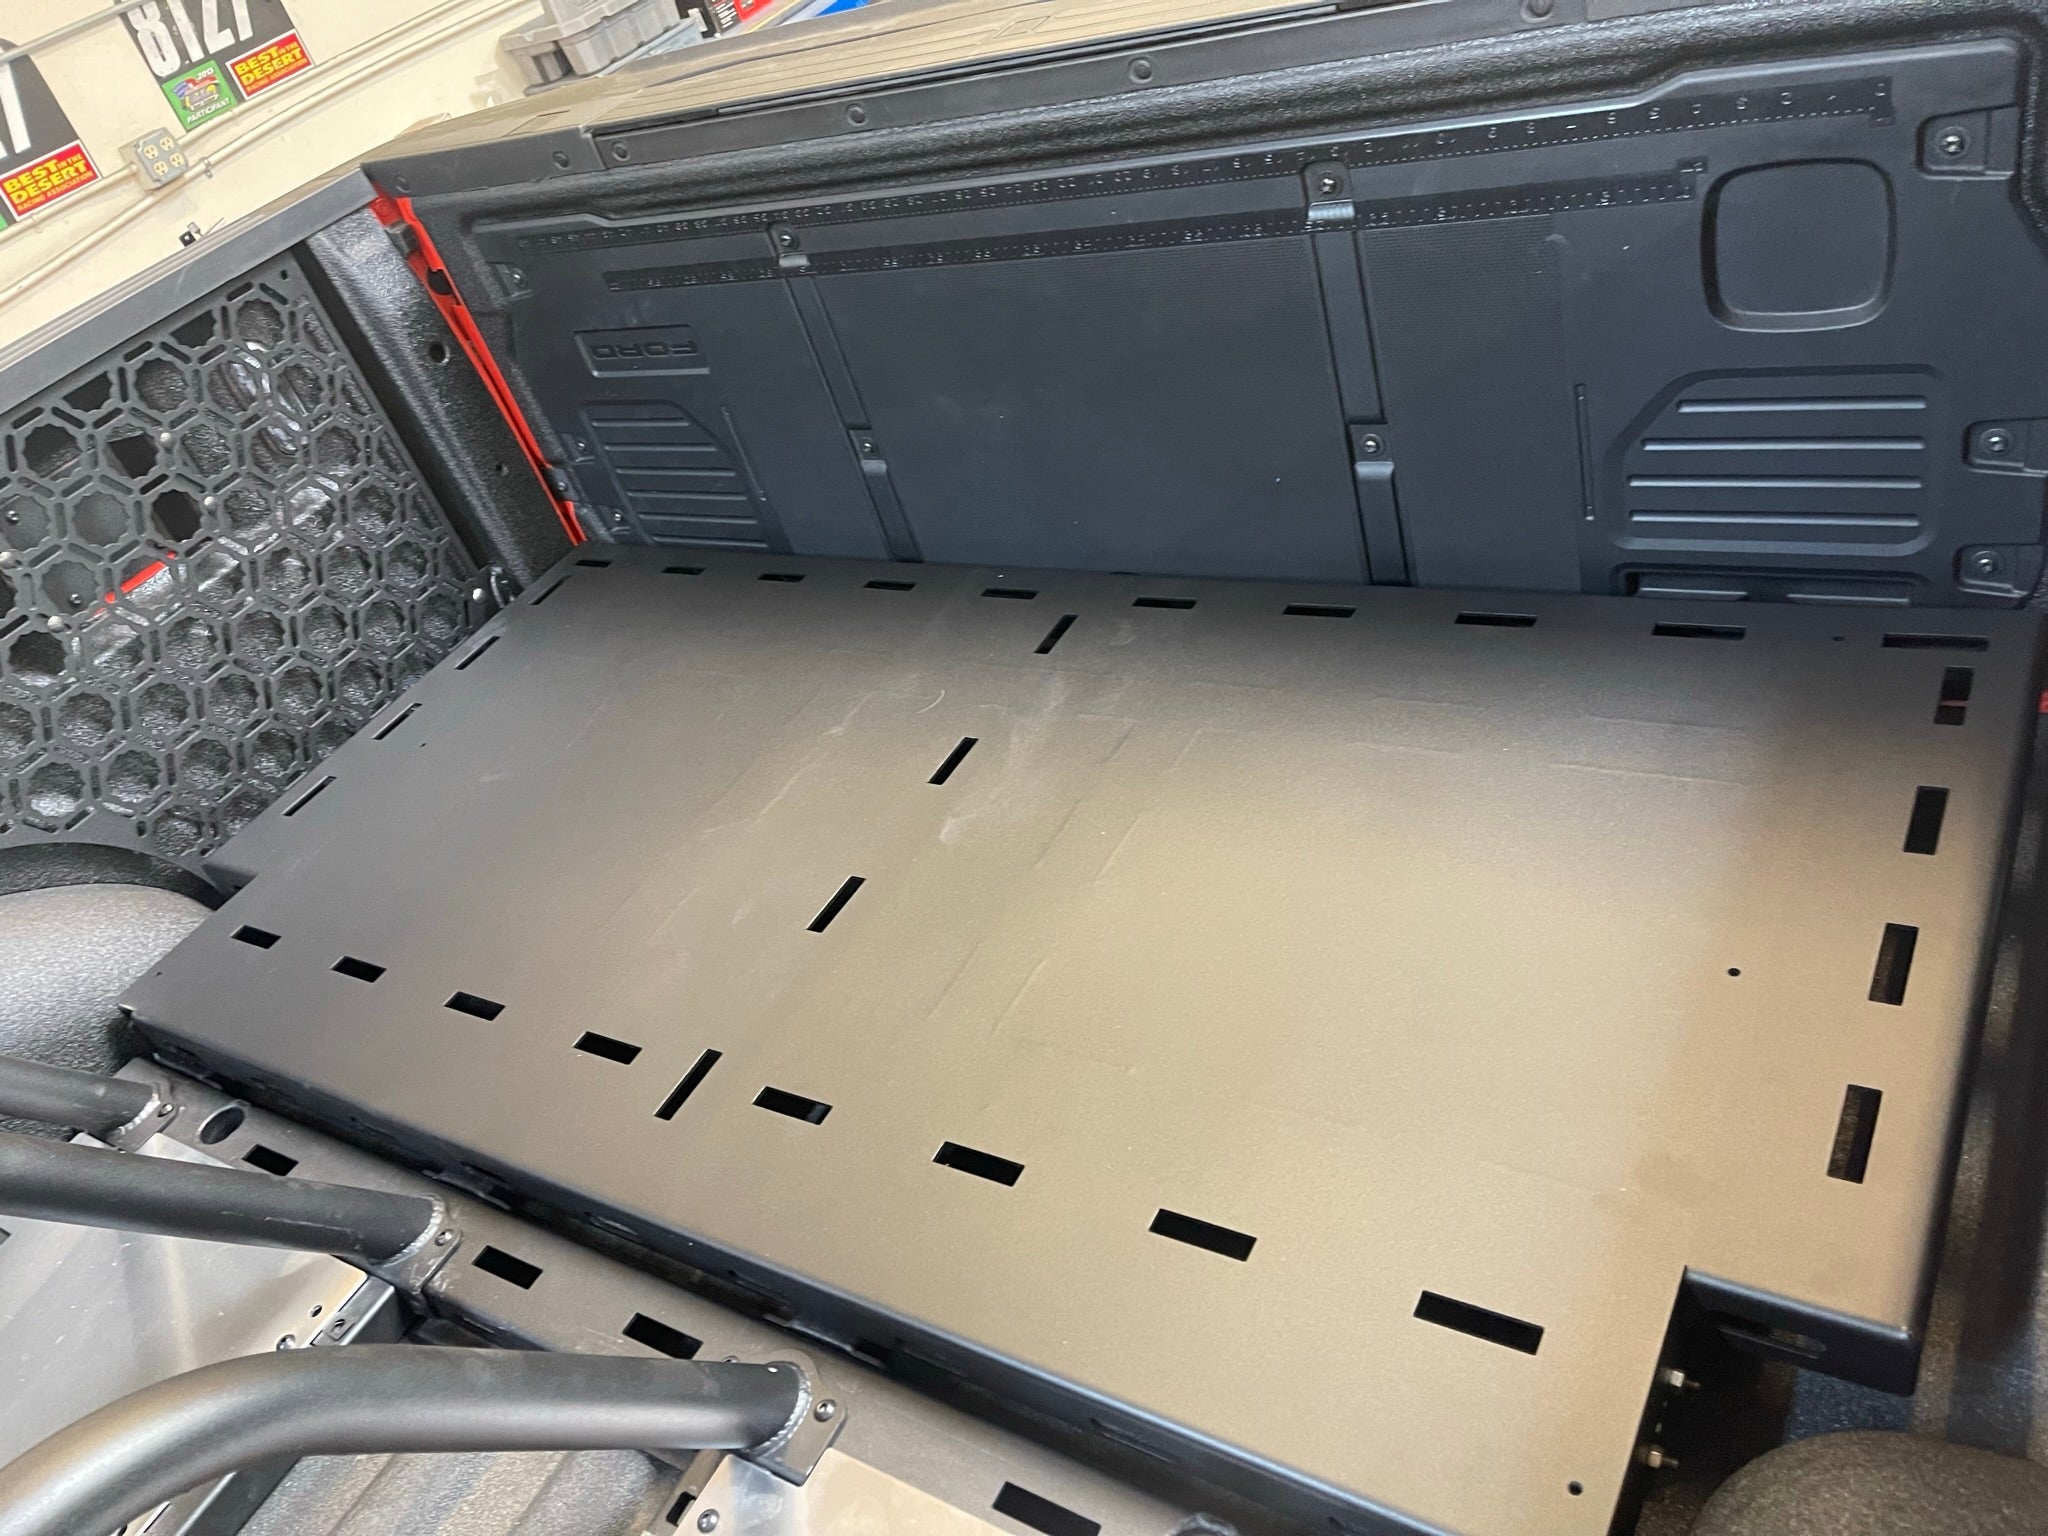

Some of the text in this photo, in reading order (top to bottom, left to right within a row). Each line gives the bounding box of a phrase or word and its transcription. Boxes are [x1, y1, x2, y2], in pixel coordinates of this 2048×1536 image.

[234, 45, 279, 75] BEST
[240, 47, 303, 86] DESERT
[187, 97, 230, 123] PARTICIPANT
[2, 159, 58, 193] BEST
[10, 160, 87, 204] DESERT
[586, 340, 698, 361] FORD
